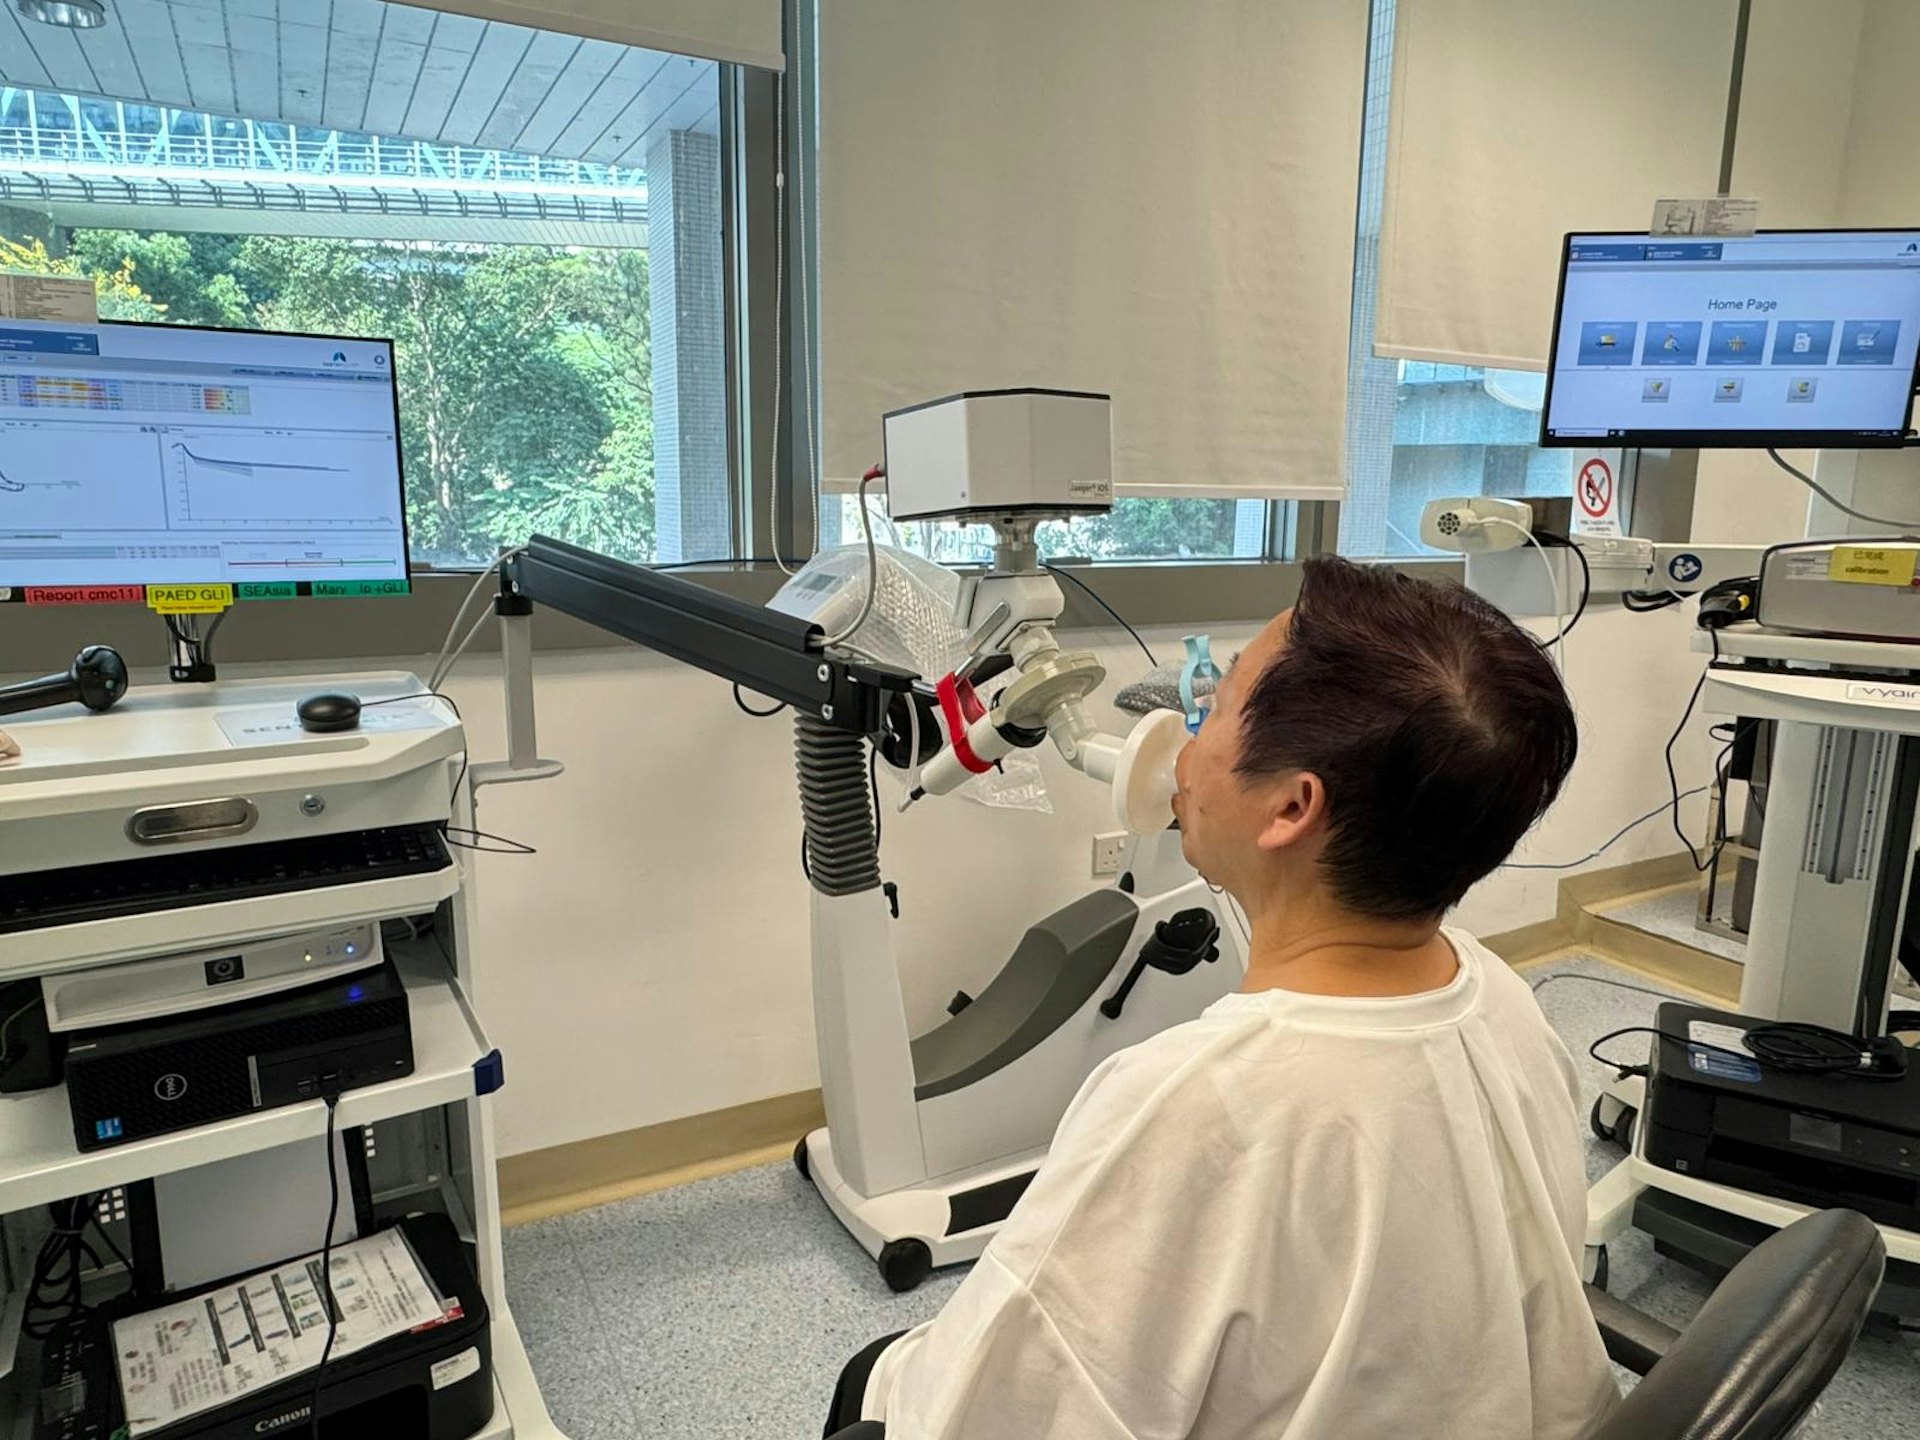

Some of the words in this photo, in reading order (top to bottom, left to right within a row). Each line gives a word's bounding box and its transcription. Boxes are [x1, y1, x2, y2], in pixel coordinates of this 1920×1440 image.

[1708, 298, 1744, 310] Home
[1746, 298, 1778, 312] Page
[33, 589, 84, 602] Report
[155, 589, 196, 601] PAED
[201, 588, 225, 601] GLI
[243, 585, 291, 597] SEAsia
[316, 584, 346, 595] Mary
[254, 1405, 311, 1433] Canon
